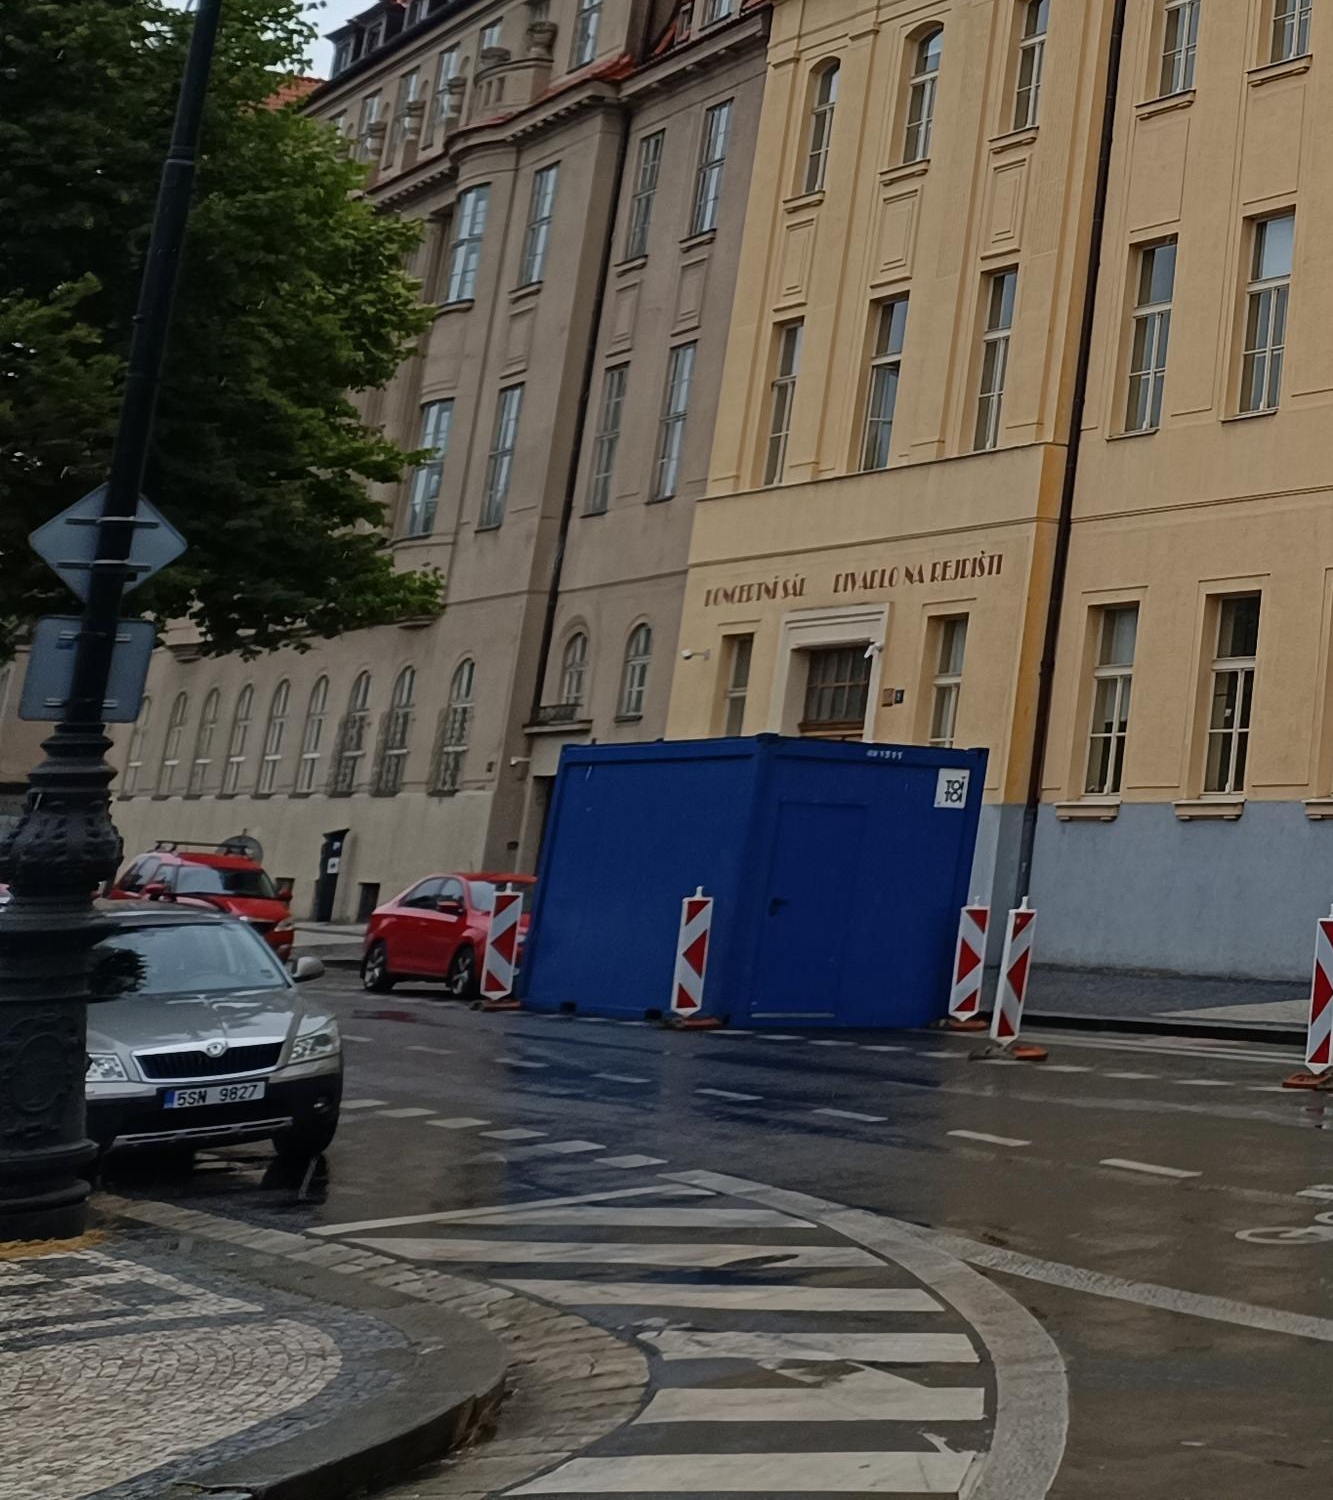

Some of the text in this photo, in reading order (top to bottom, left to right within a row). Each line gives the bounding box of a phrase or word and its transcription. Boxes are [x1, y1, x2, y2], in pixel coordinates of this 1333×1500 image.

[833, 550, 1003, 593] DIVADLO NA REJDIŠTI
